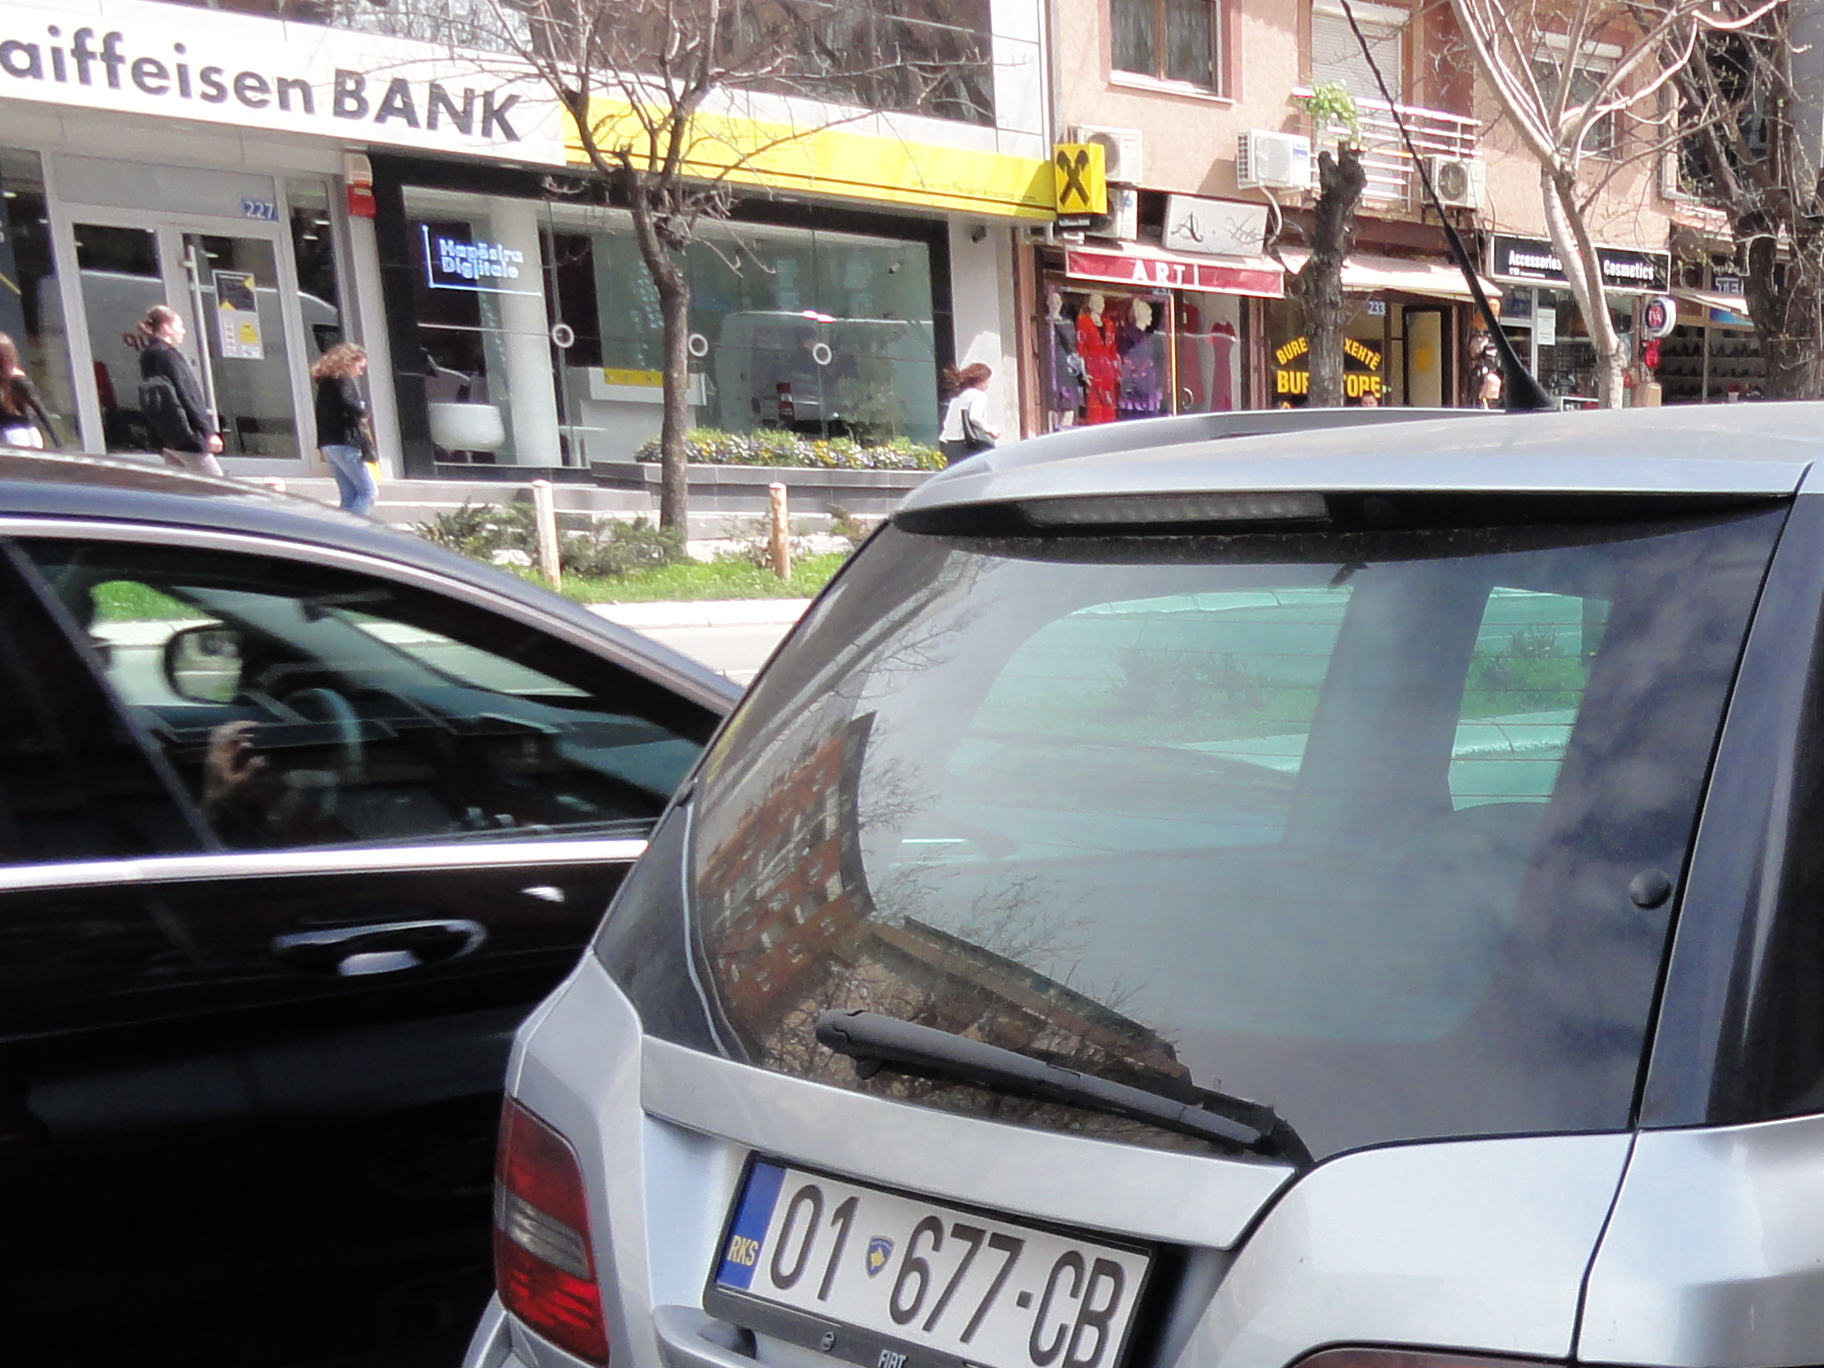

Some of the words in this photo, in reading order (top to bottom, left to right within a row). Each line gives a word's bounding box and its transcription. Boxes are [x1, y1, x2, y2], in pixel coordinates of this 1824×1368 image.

[333, 67, 522, 142] BANK
[245, 201, 274, 219] 227
[1603, 259, 1654, 280] Cosmetics
[1344, 336, 1382, 372] XEHTË
[725, 1233, 760, 1268] RKS
